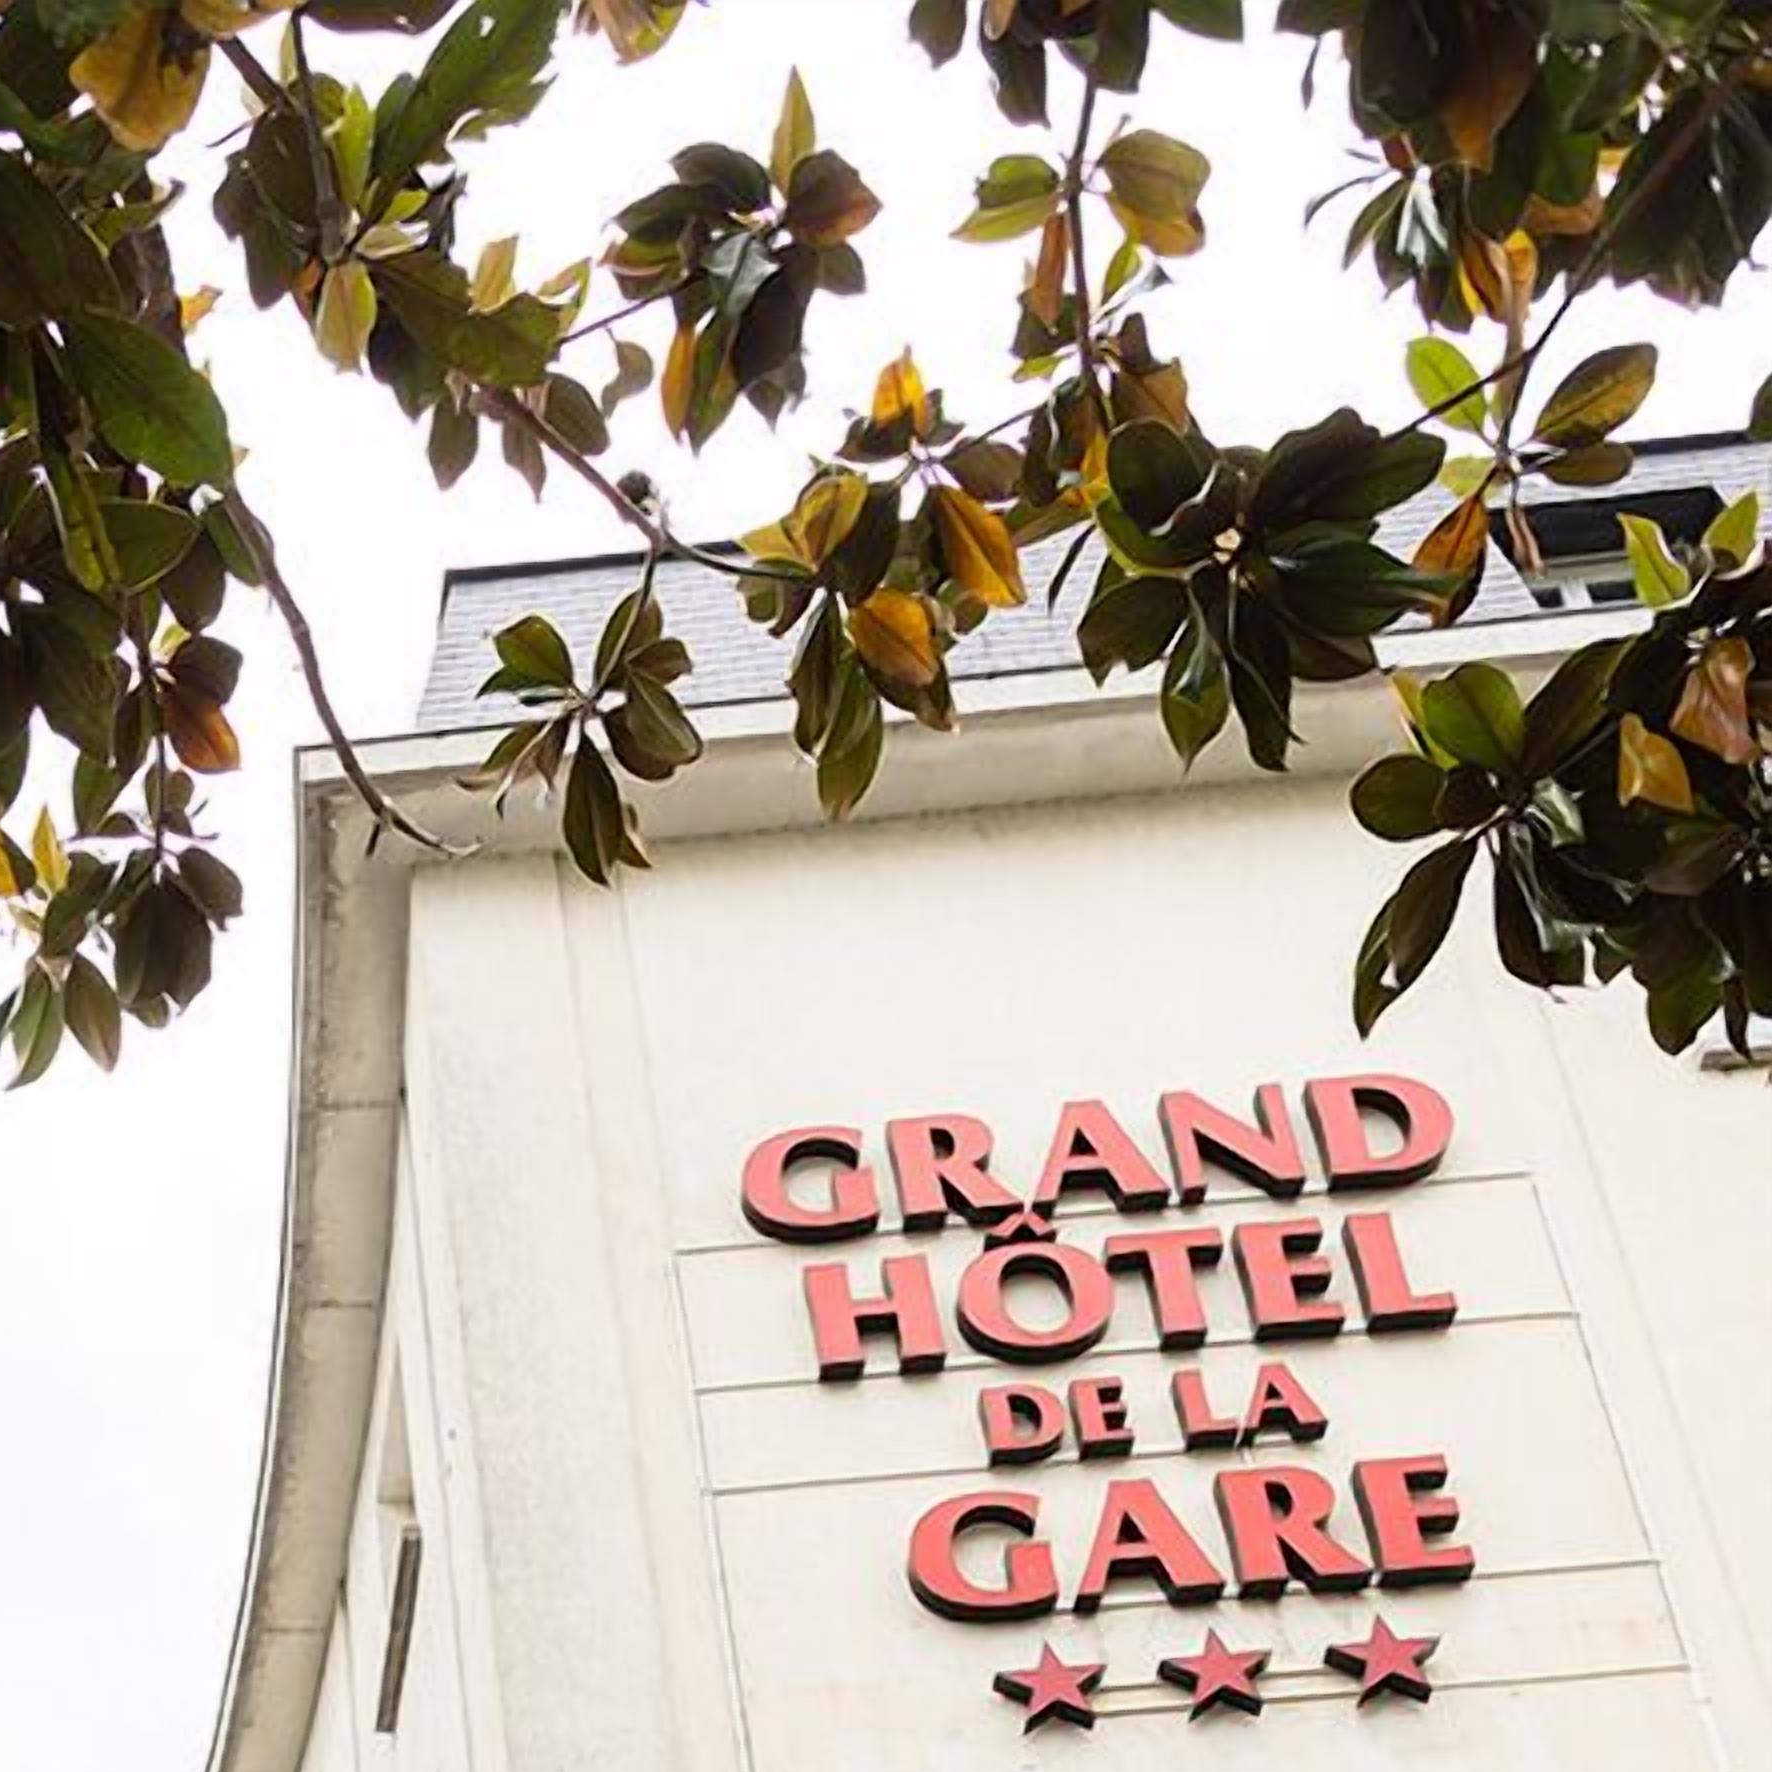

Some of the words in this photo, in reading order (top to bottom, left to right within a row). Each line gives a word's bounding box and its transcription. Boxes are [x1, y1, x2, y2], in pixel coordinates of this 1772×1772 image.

[741, 1073, 1455, 1244] GRAND
[803, 1212, 1457, 1382] HÔTEL
[979, 1376, 1135, 1468] DE
[1173, 1362, 1328, 1451] LA
[908, 1454, 1476, 1622] GARE
